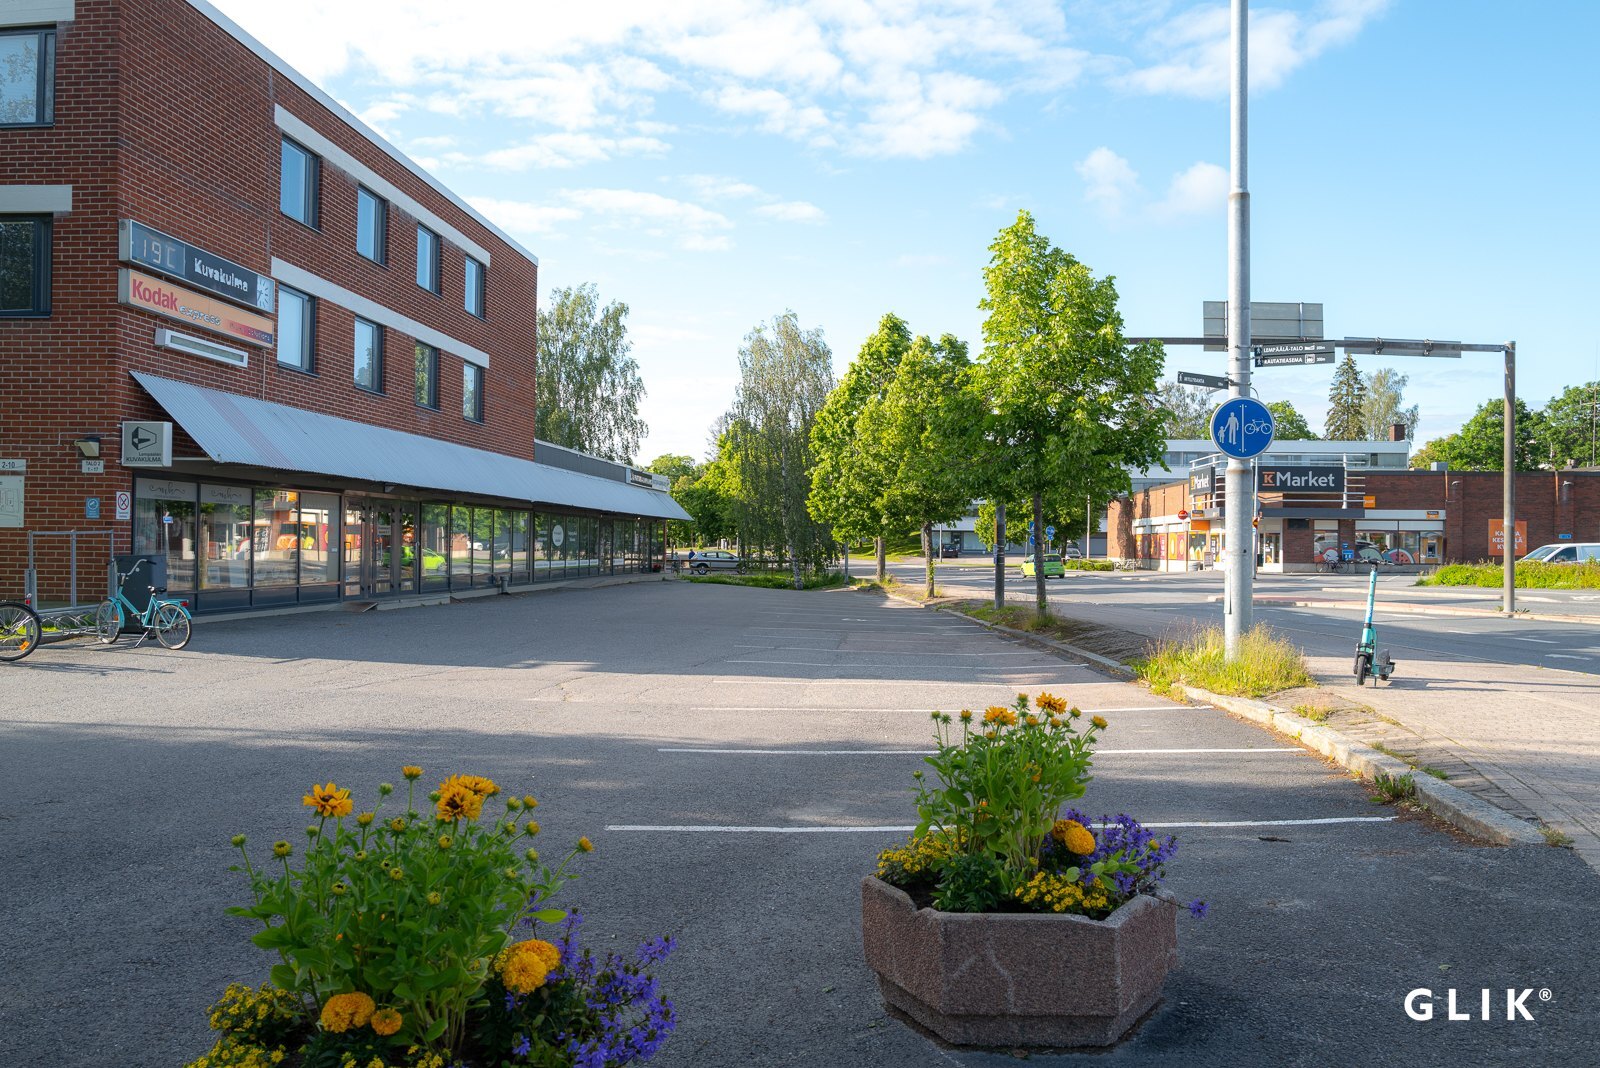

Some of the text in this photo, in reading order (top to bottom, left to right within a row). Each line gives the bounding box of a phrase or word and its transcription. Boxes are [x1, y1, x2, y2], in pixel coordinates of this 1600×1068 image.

[194, 257, 249, 293] Kuvakulma
[132, 279, 222, 326] Kodak express
[1263, 345, 1304, 353] LEMPÄÄLÄ-TALO
[1, 461, 16, 469] 2-10
[1196, 473, 1210, 489] Market
[1276, 471, 1335, 488] Market
